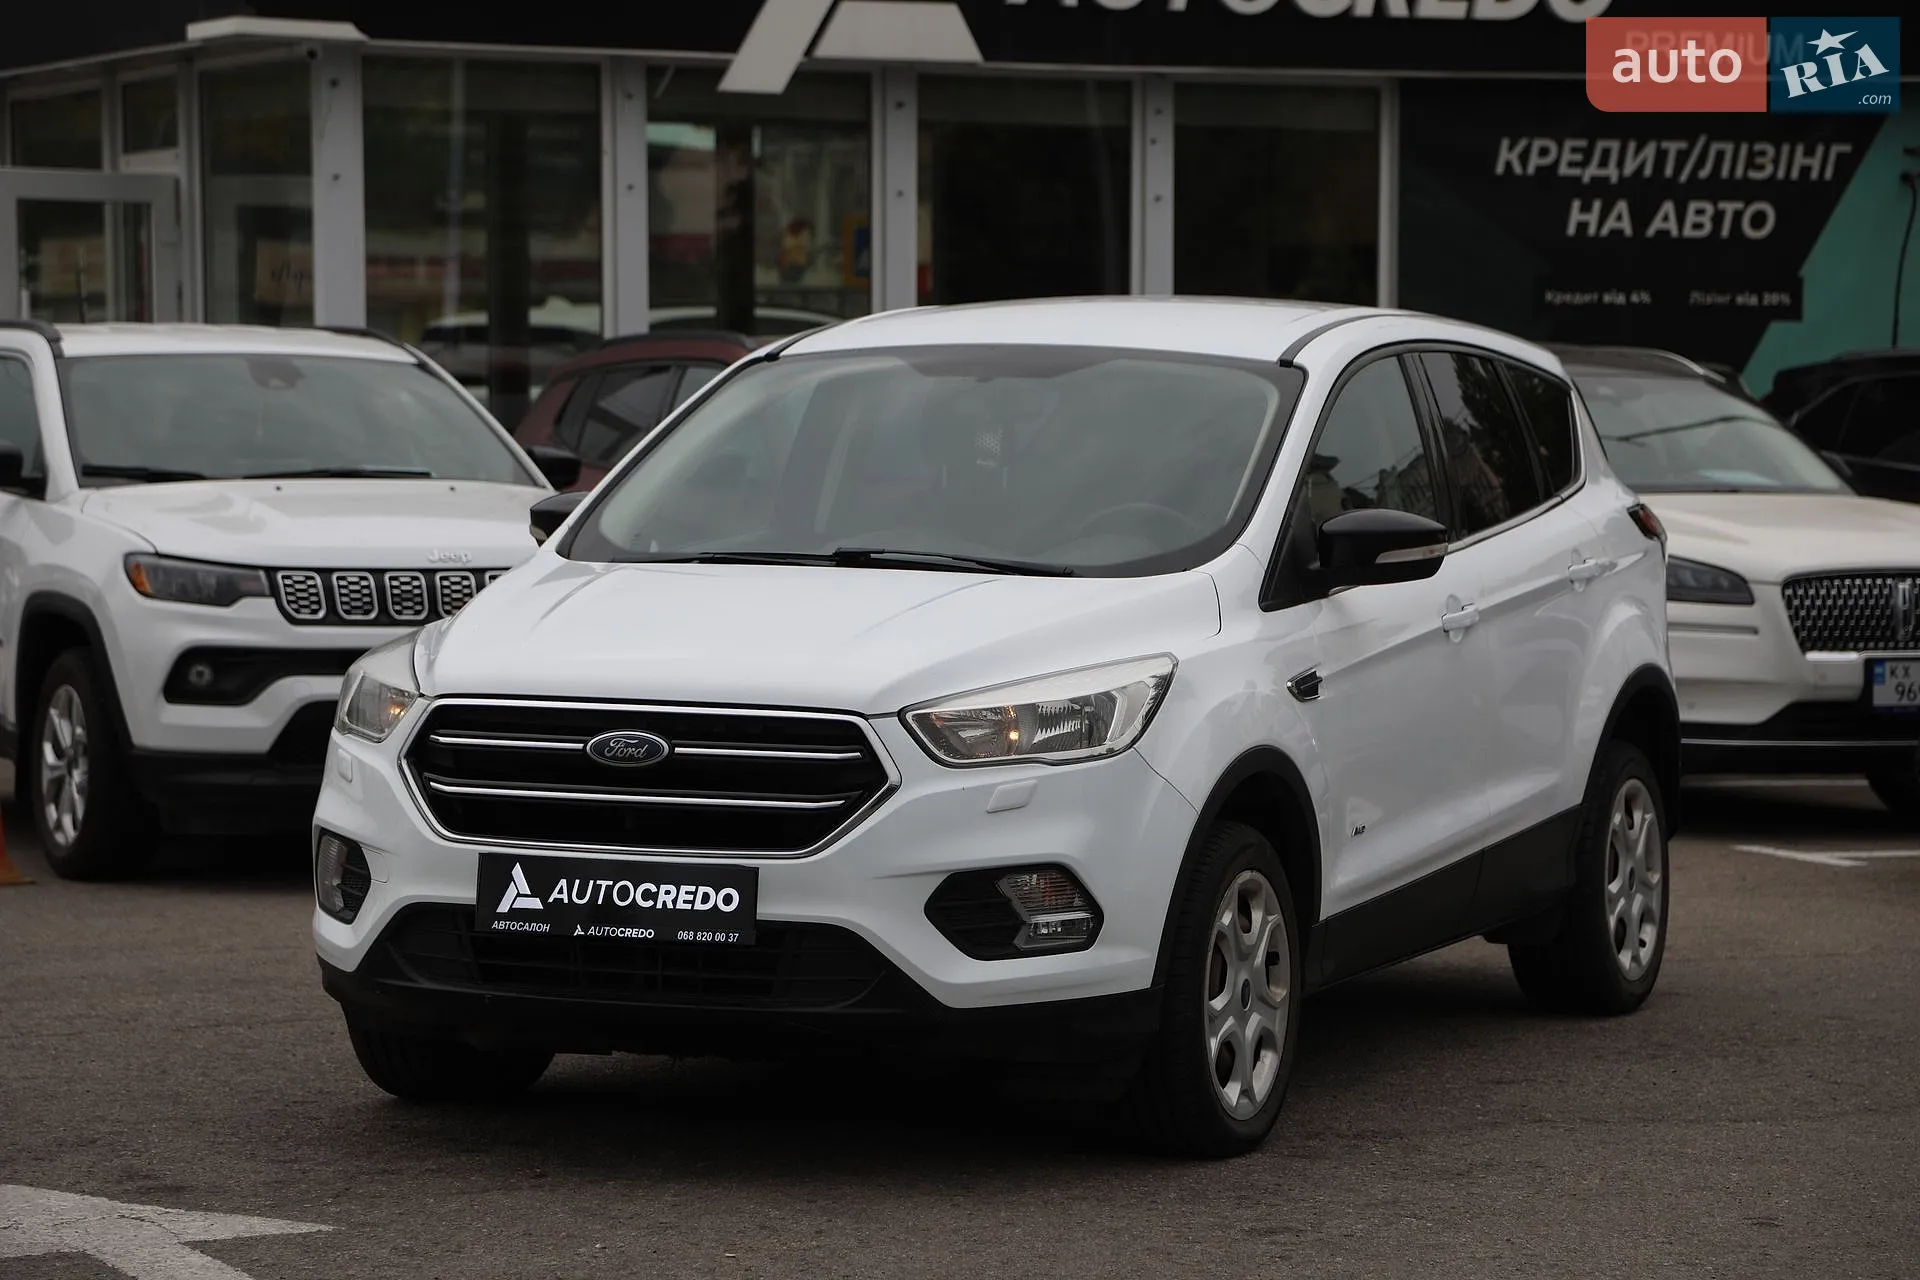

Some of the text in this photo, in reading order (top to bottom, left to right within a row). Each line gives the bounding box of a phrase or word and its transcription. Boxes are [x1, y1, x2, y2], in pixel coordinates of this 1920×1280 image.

[1495, 134, 1852, 184] КРЕДИТ/ЛІЗІНГ
[1566, 198, 1776, 240] НА АВТО
[428, 548, 472, 565] Jeep
[1895, 681, 1920, 702] 96
[604, 738, 649, 758] Ford
[547, 878, 740, 913] AUTOCREDO
[491, 920, 551, 933] АВТОСАЛОН
[587, 926, 655, 939] AUTOCREDO
[677, 930, 739, 943] 068 820 00 37
